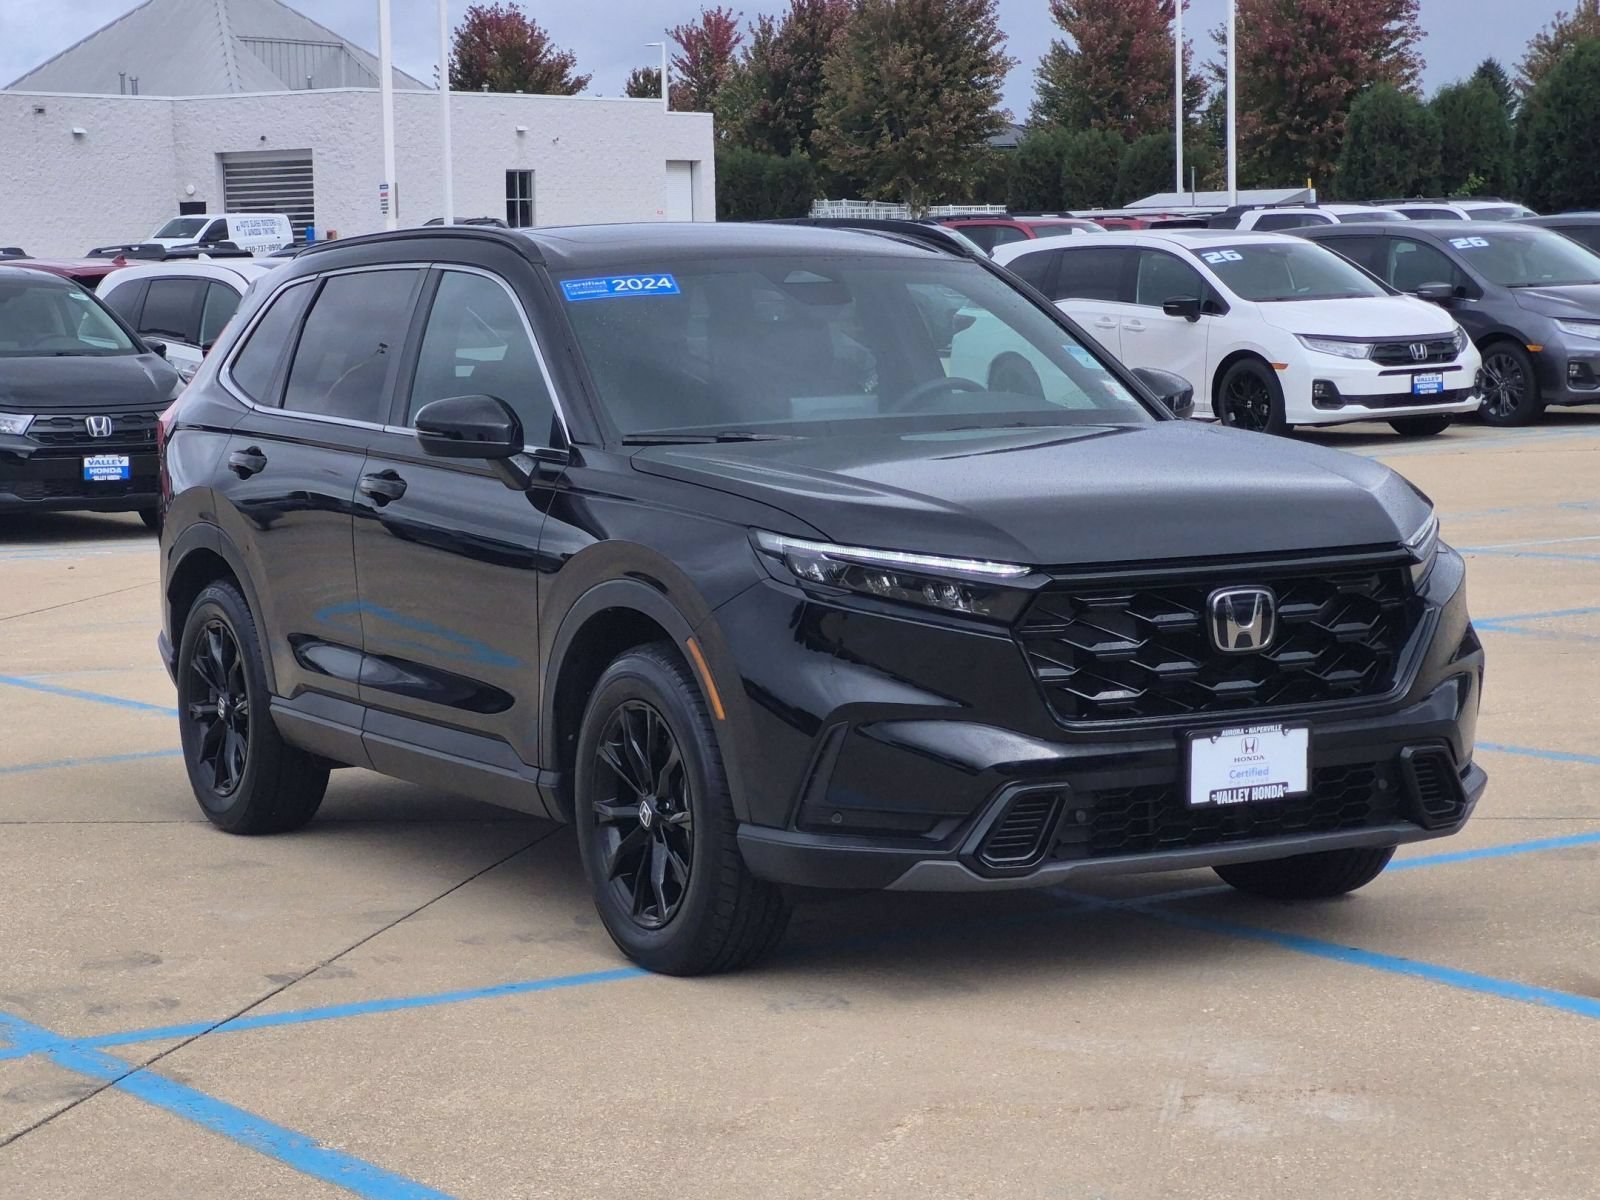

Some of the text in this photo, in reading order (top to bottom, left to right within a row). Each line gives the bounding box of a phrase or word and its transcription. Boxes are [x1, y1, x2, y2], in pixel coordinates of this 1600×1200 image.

[1449, 237, 1489, 249] 26
[1201, 250, 1243, 264] 26
[612, 278, 672, 291] 2024
[1221, 724, 1283, 737] AURORA NAPERVILLE
[1234, 755, 1265, 763] HONDA
[1229, 767, 1270, 779] Certified
[1216, 784, 1284, 805] VALLEY HONDA
